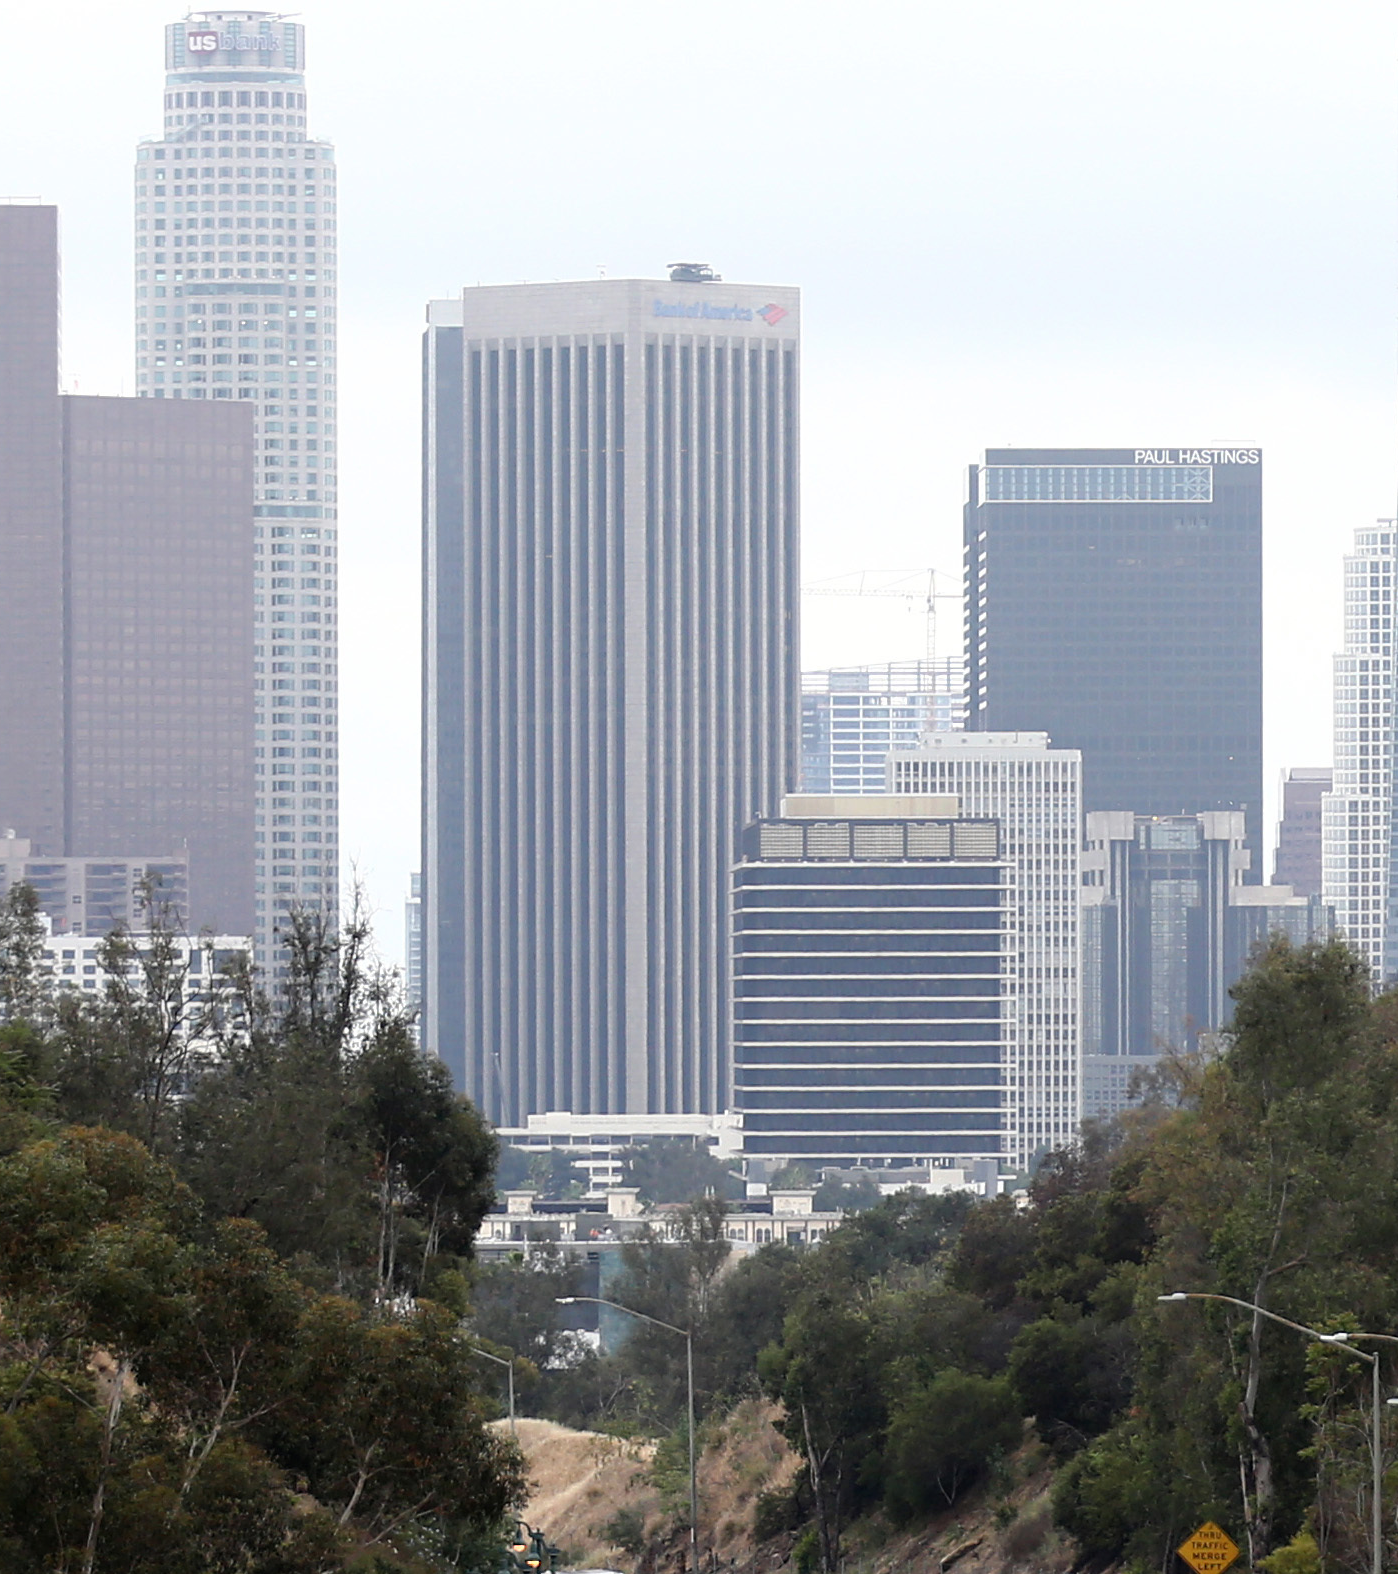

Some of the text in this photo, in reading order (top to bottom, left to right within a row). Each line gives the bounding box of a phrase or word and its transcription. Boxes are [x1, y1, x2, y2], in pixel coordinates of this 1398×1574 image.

[1134, 449, 1260, 464] PAUL HASTINGS
[1199, 1531, 1222, 1539] THRU
[1192, 1541, 1228, 1550] TRAFFIC
[1192, 1552, 1227, 1560] MERGE
